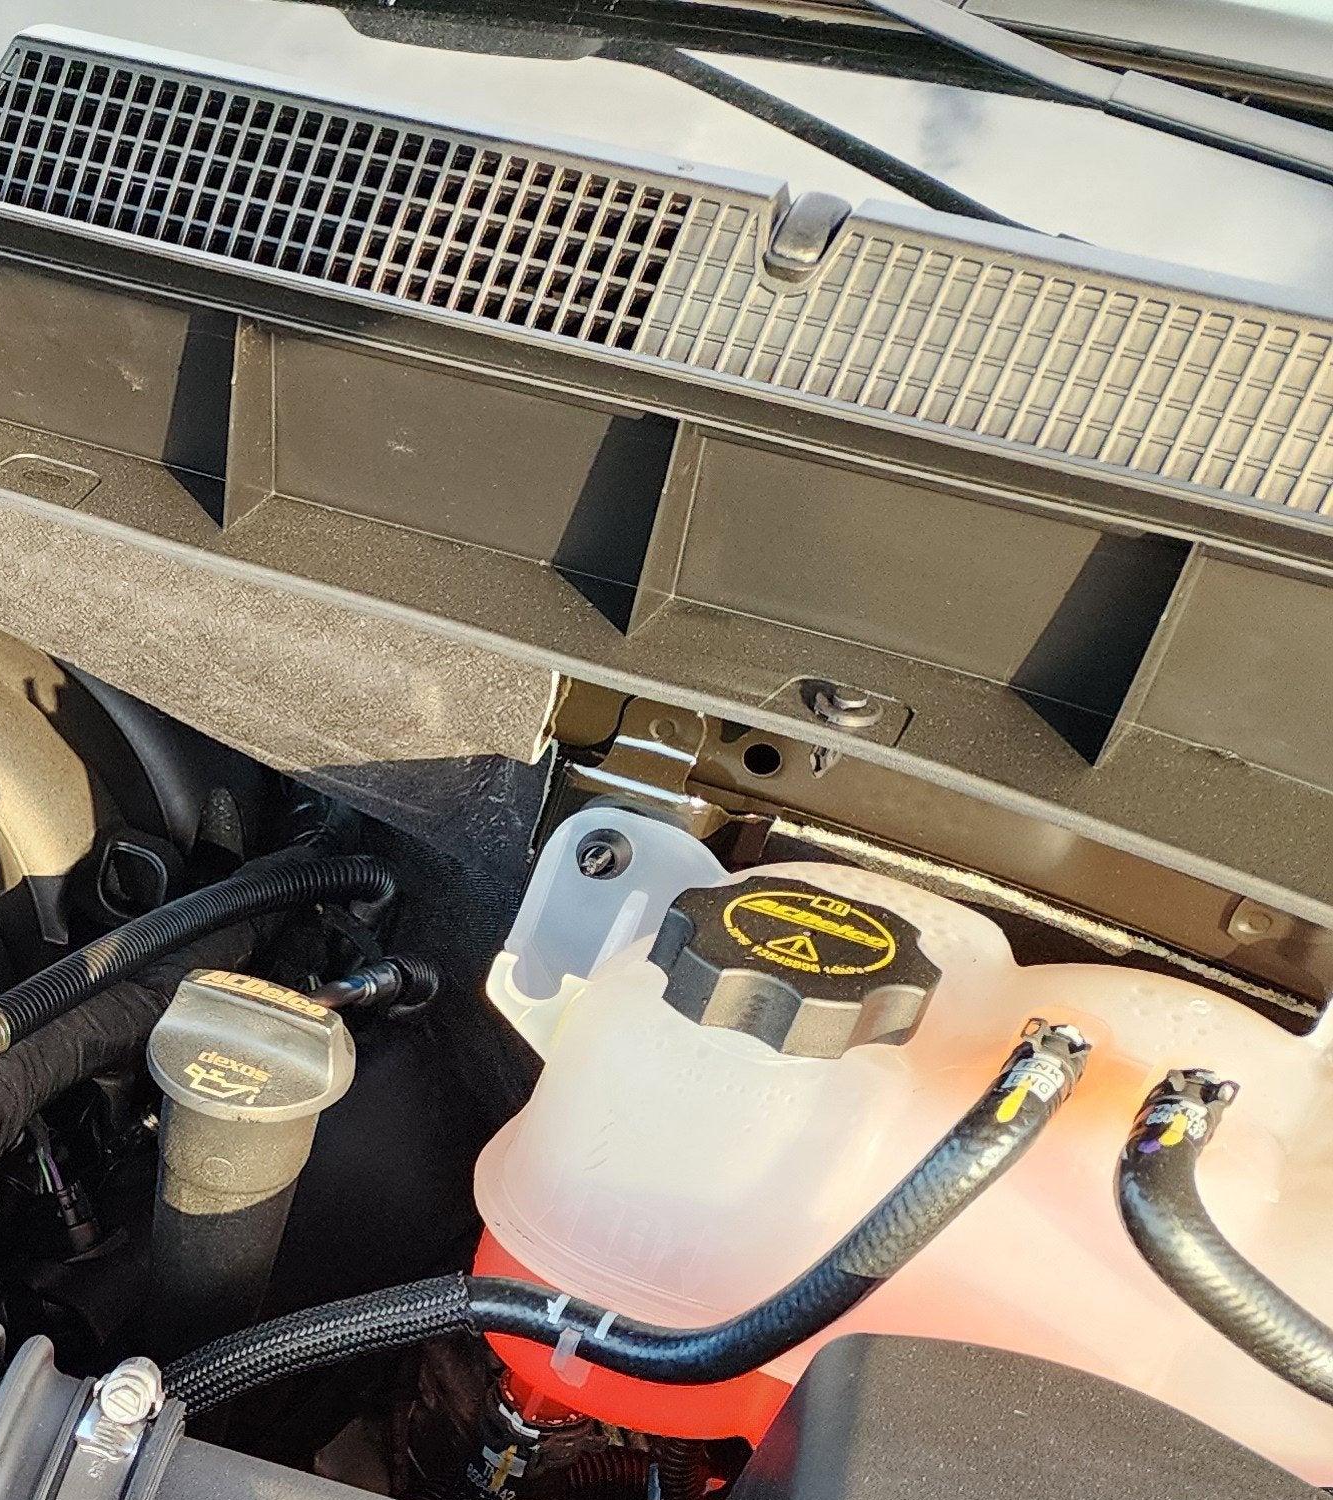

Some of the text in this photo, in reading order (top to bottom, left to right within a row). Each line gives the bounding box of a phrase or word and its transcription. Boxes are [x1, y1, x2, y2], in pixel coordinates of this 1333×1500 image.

[739, 898, 890, 949] ACDelco
[196, 970, 329, 1019] ACDelco
[197, 1050, 273, 1083] dexos
